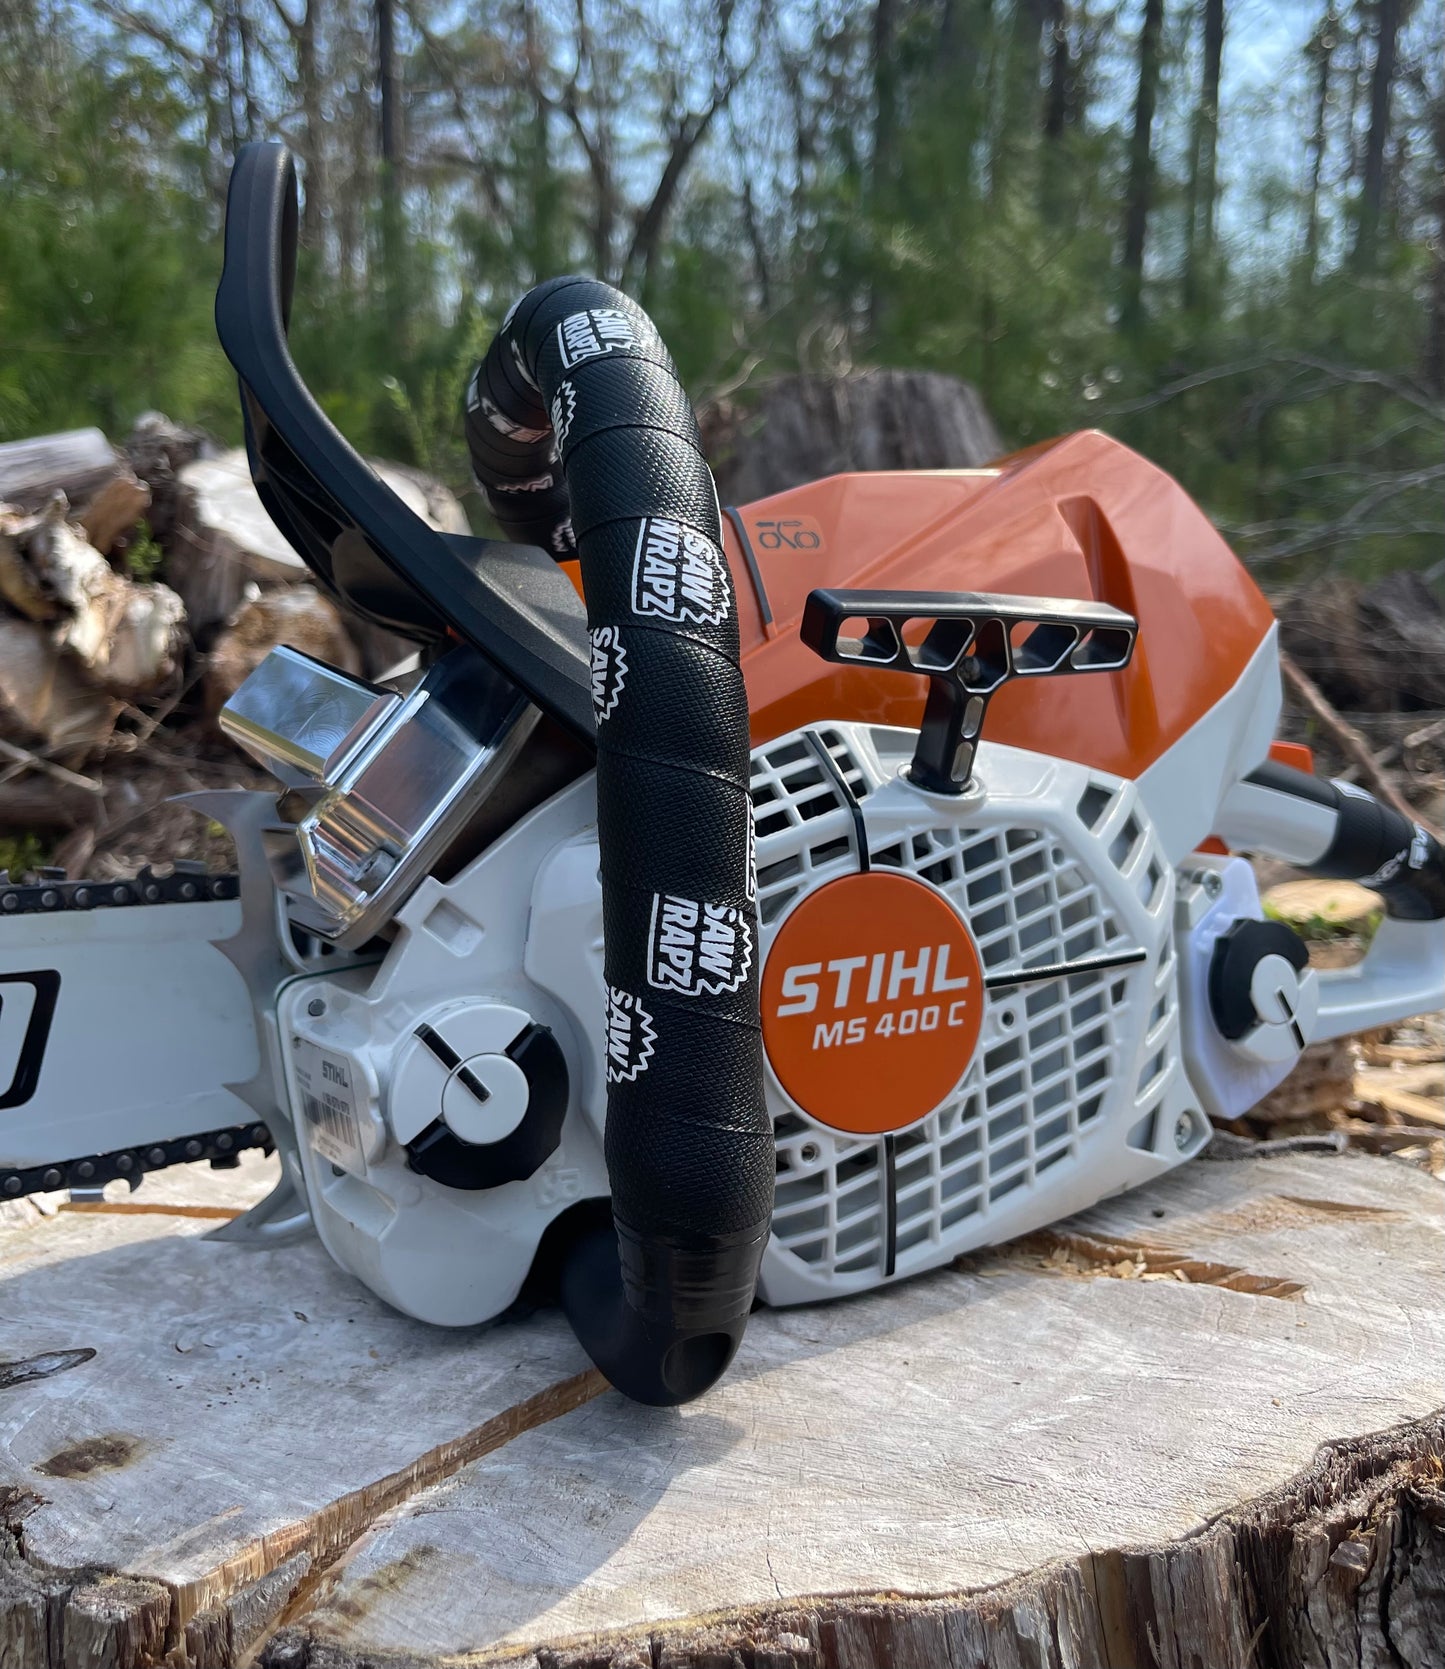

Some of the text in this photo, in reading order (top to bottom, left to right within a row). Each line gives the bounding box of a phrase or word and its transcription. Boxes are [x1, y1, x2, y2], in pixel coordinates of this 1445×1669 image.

[590, 308, 636, 340] SAW
[680, 532, 715, 614] SAW
[591, 626, 613, 707] SAW
[699, 901, 737, 982] SAW
[776, 943, 970, 1018] STIHL
[609, 984, 633, 1068] SAW
[811, 999, 968, 1051] MS 400 C
[321, 1059, 349, 1089] STIHL
